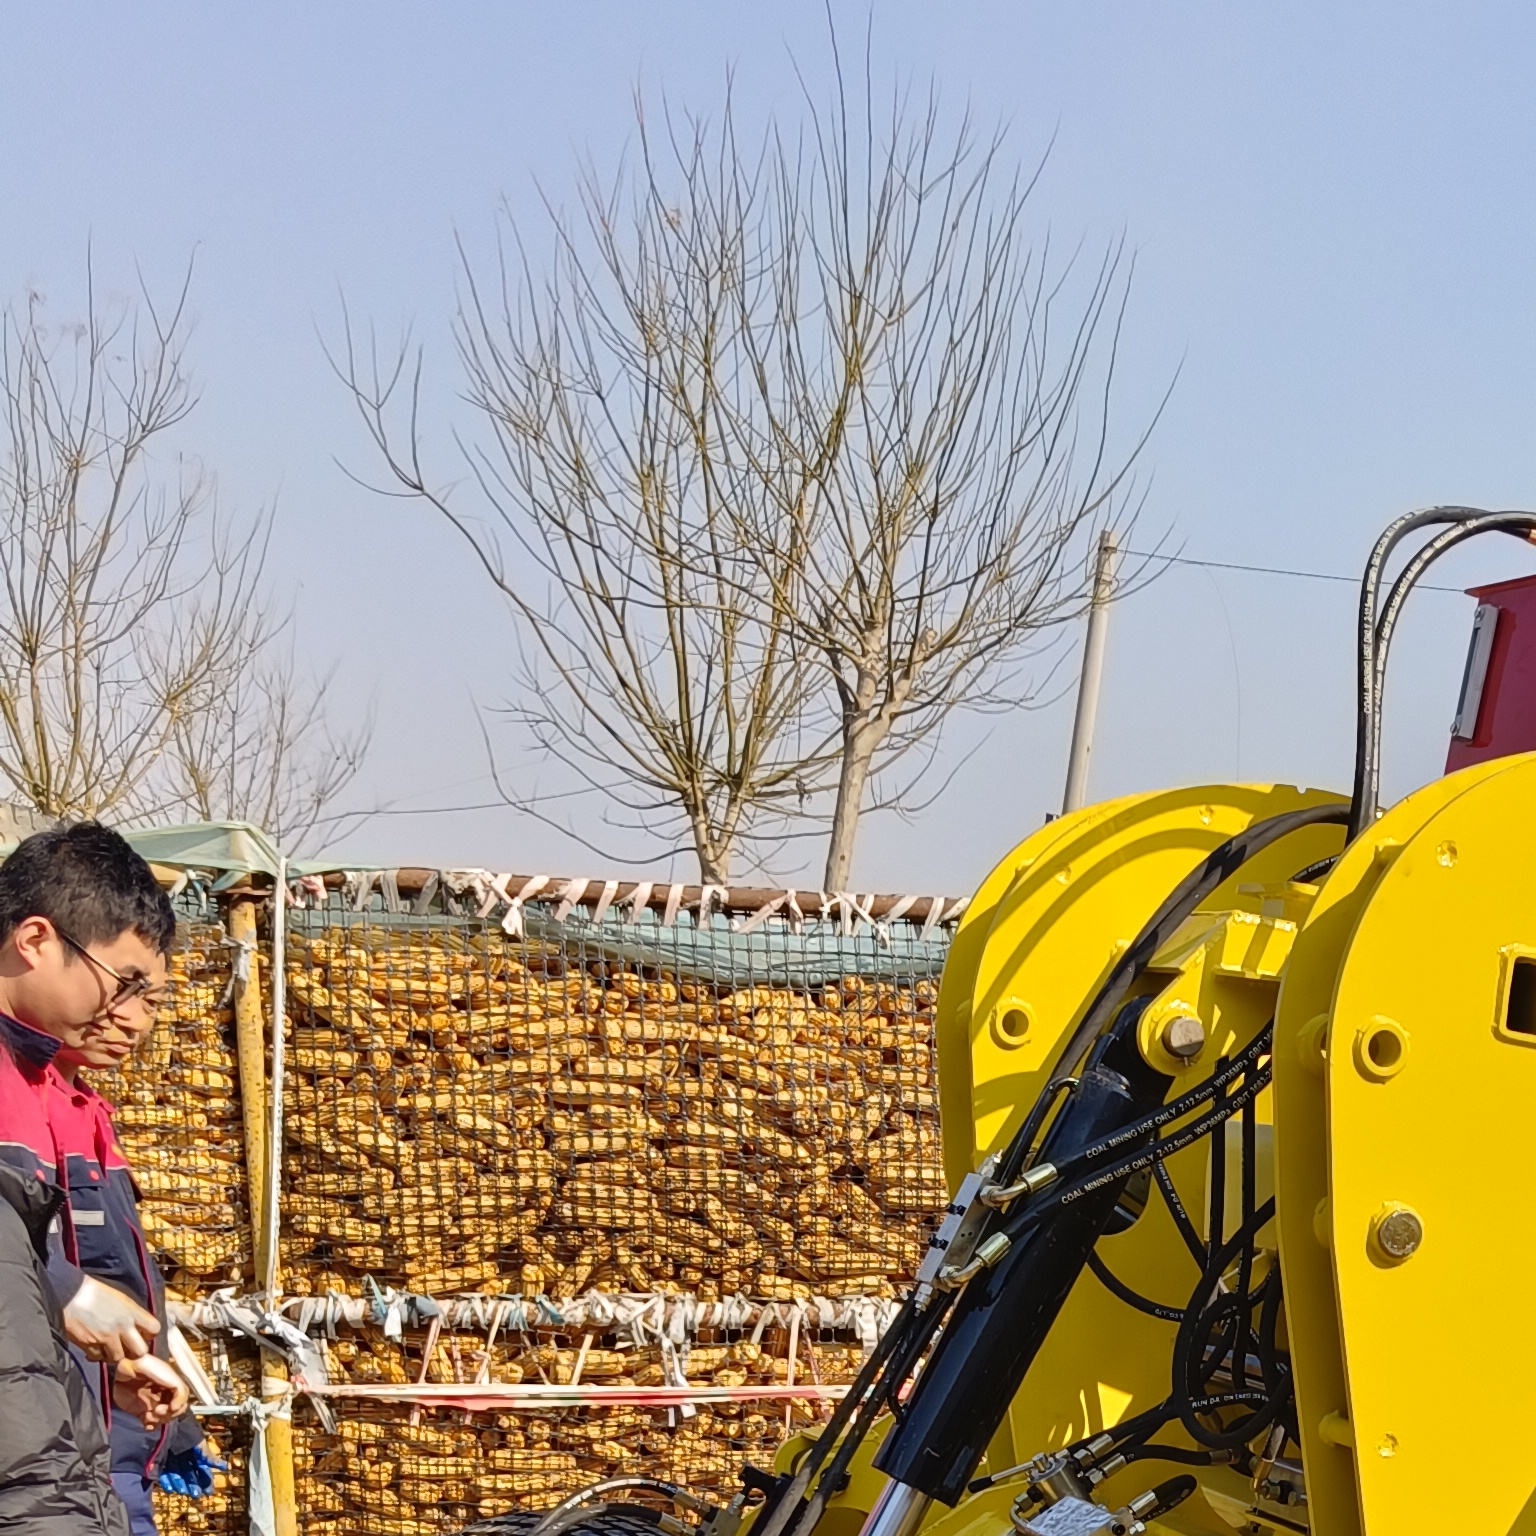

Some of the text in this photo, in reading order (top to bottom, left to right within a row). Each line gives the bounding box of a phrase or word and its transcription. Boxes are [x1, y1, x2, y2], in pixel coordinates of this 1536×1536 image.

[1086, 1142, 1109, 1159] COAL
[1109, 1129, 1138, 1148] MINING
[1138, 1119, 1154, 1133] USE
[1155, 1108, 1177, 1125] ONLY
[1061, 1187, 1085, 1204] COAL
[1084, 1173, 1114, 1192] MINING
[1114, 1164, 1132, 1178] USE
[1132, 1154, 1154, 1170] ONLY
